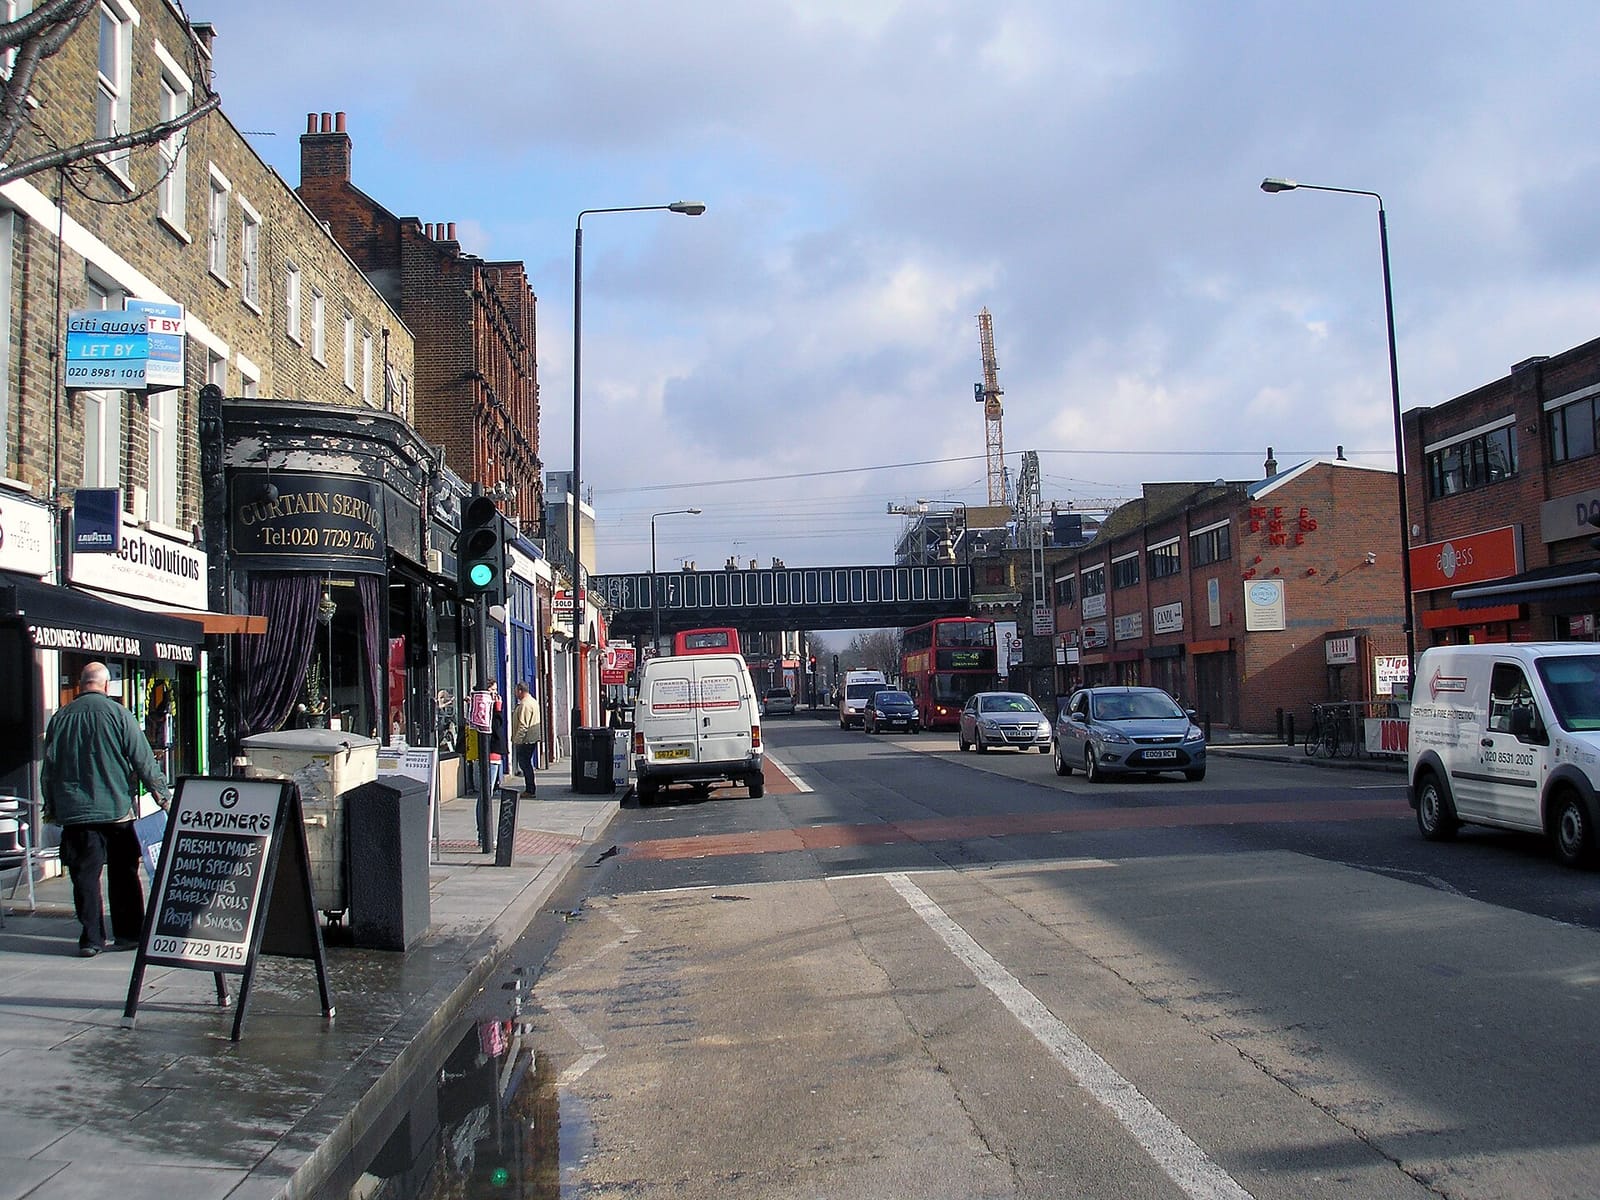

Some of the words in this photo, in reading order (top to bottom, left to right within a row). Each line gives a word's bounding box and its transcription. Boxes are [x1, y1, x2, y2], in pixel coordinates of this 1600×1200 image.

[71, 318, 97, 331] citi
[101, 322, 146, 334] quays
[162, 320, 181, 332] BY
[81, 344, 110, 357] LET
[113, 344, 134, 357] BY
[68, 367, 88, 377] 020
[91, 368, 116, 378] 8981
[121, 369, 145, 378] 1010
[239, 492, 329, 526] CURTAIN
[77, 531, 112, 542] LAVAZZA
[322, 528, 350, 547] 7729
[353, 531, 375, 550] 2766
[149, 544, 199, 581] solutions
[81, 632, 125, 654] SANDWICH
[125, 637, 141, 656] BAR
[1484, 752, 1496, 761] 020
[1498, 752, 1513, 763] 8531
[1516, 754, 1534, 766] 2003
[180, 810, 271, 833] GARDINER'S
[178, 838, 225, 855] FRESHLY
[175, 857, 203, 873] DAILY
[205, 859, 253, 877] SPECIALS
[171, 874, 236, 893] SANDWICHES
[163, 907, 193, 929] PASTA
[203, 912, 243, 931] SNACKS
[153, 939, 177, 952] 020
[180, 941, 211, 956] 7729
[215, 945, 243, 960] 1215
